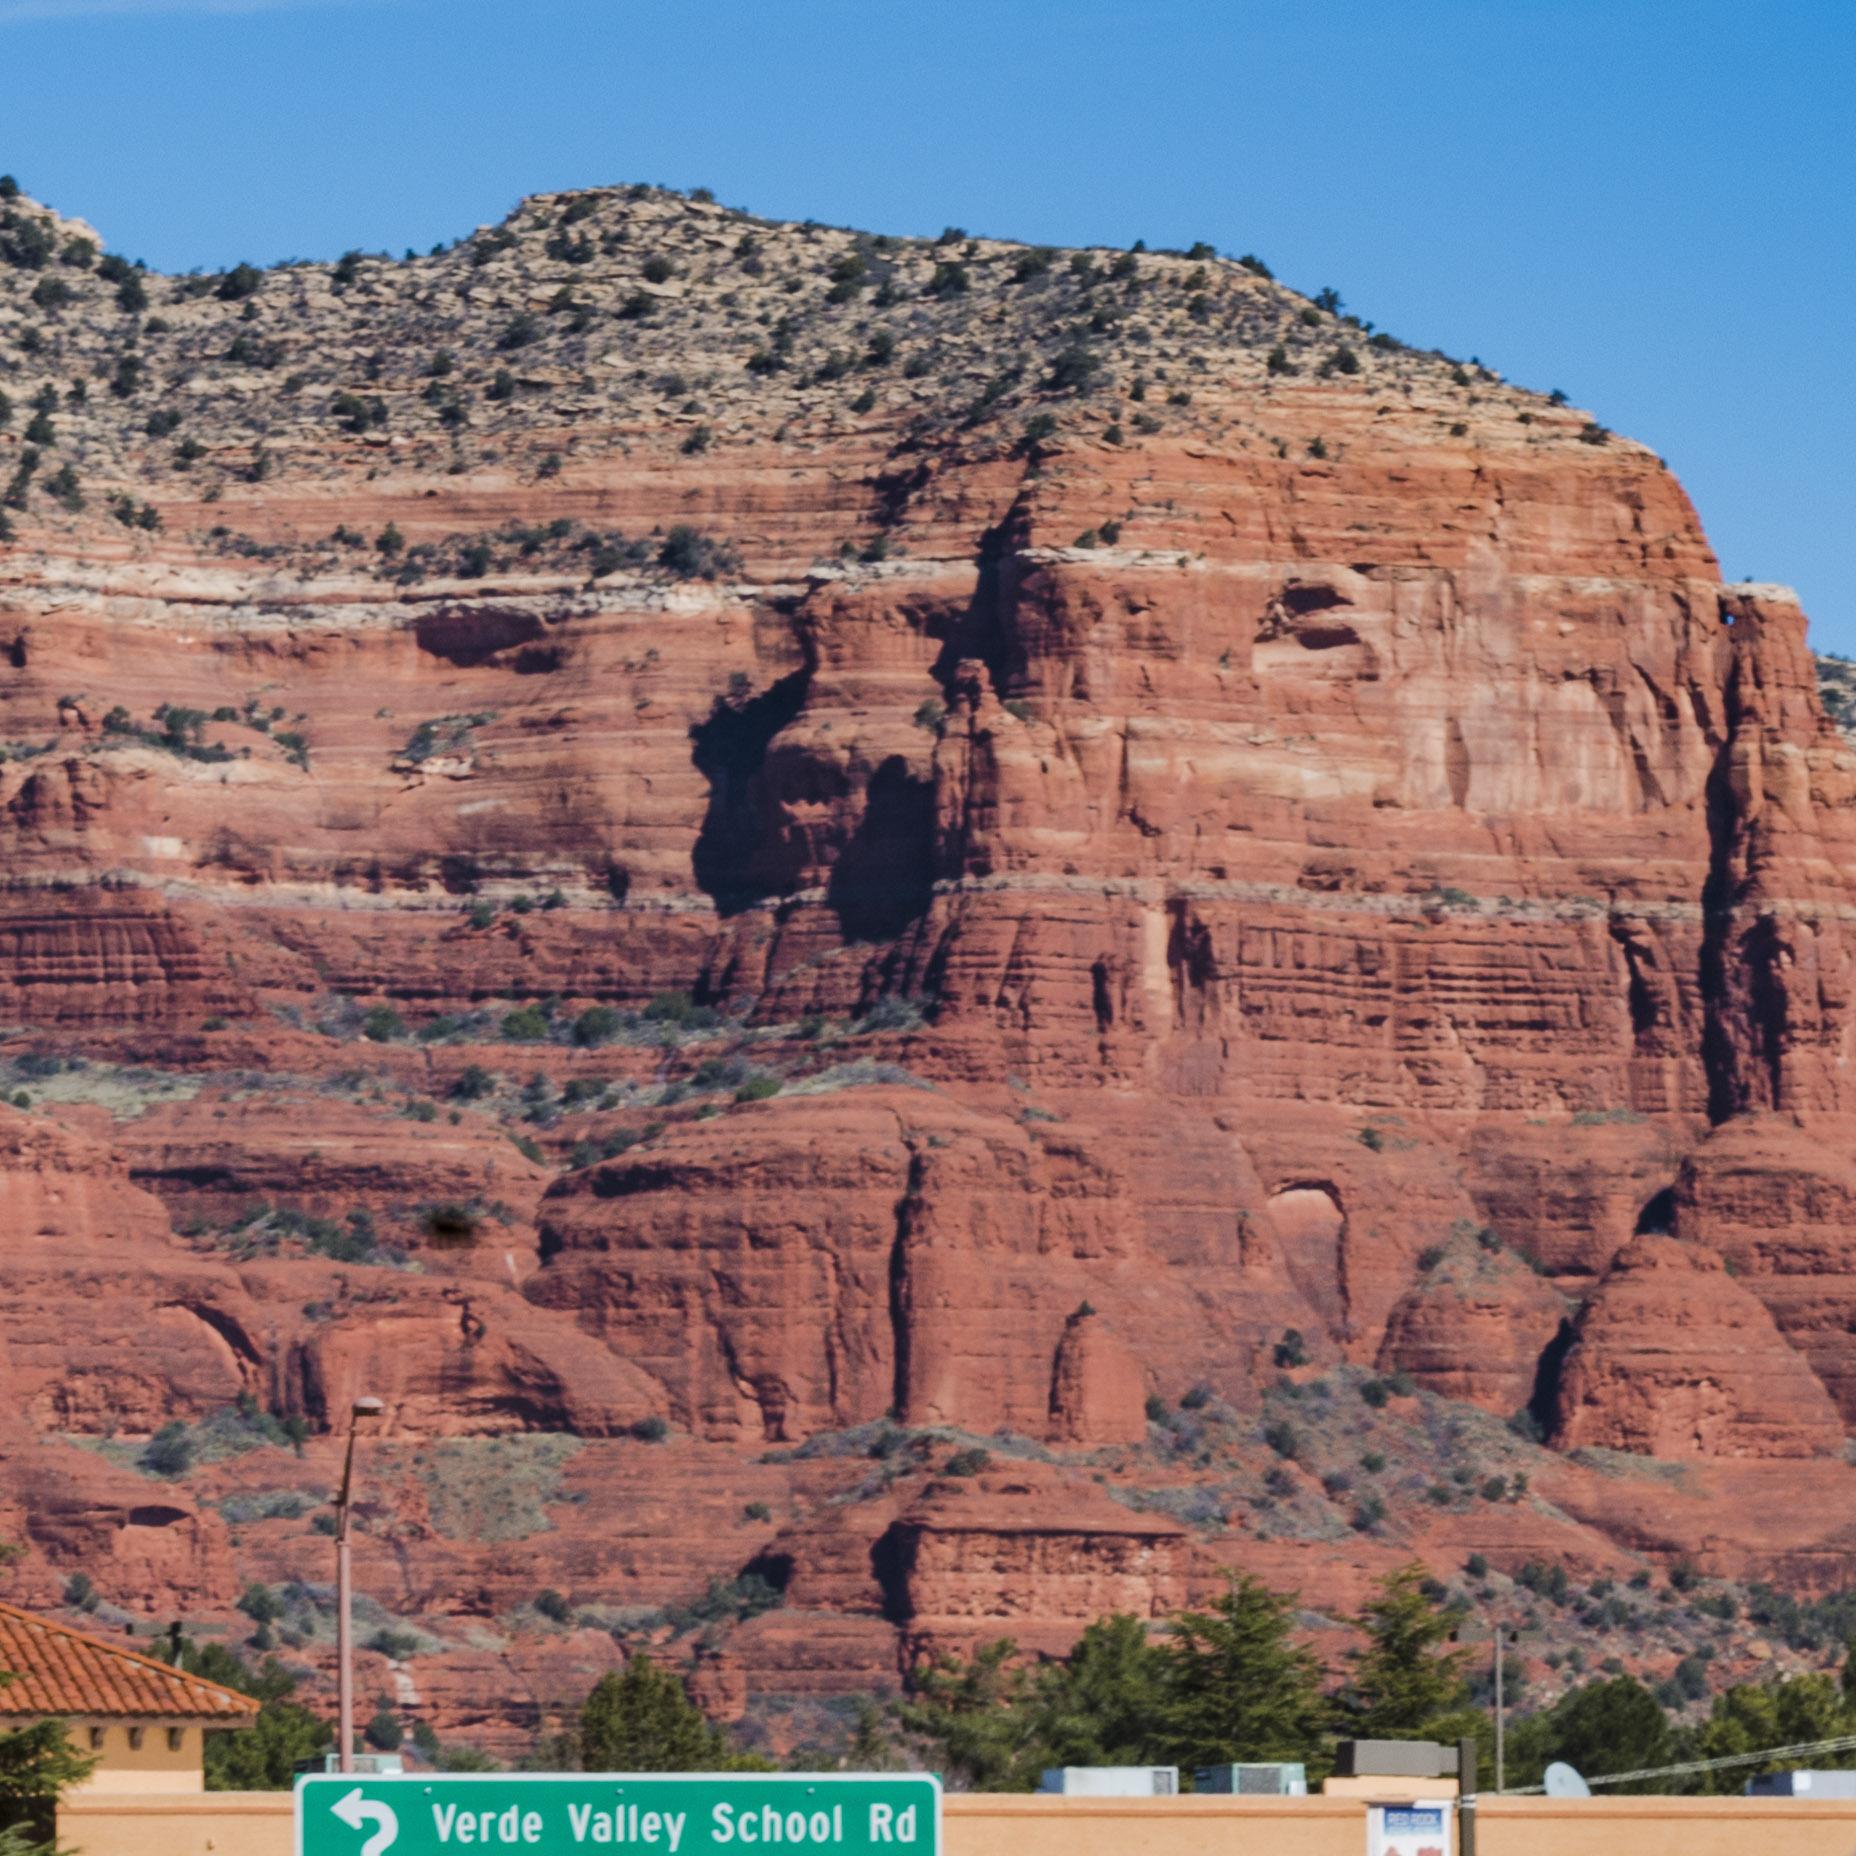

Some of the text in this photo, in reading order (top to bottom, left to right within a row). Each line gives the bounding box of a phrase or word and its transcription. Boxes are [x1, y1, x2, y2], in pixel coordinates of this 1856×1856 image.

[431, 1802, 917, 1853] Verde Valley School Rd
